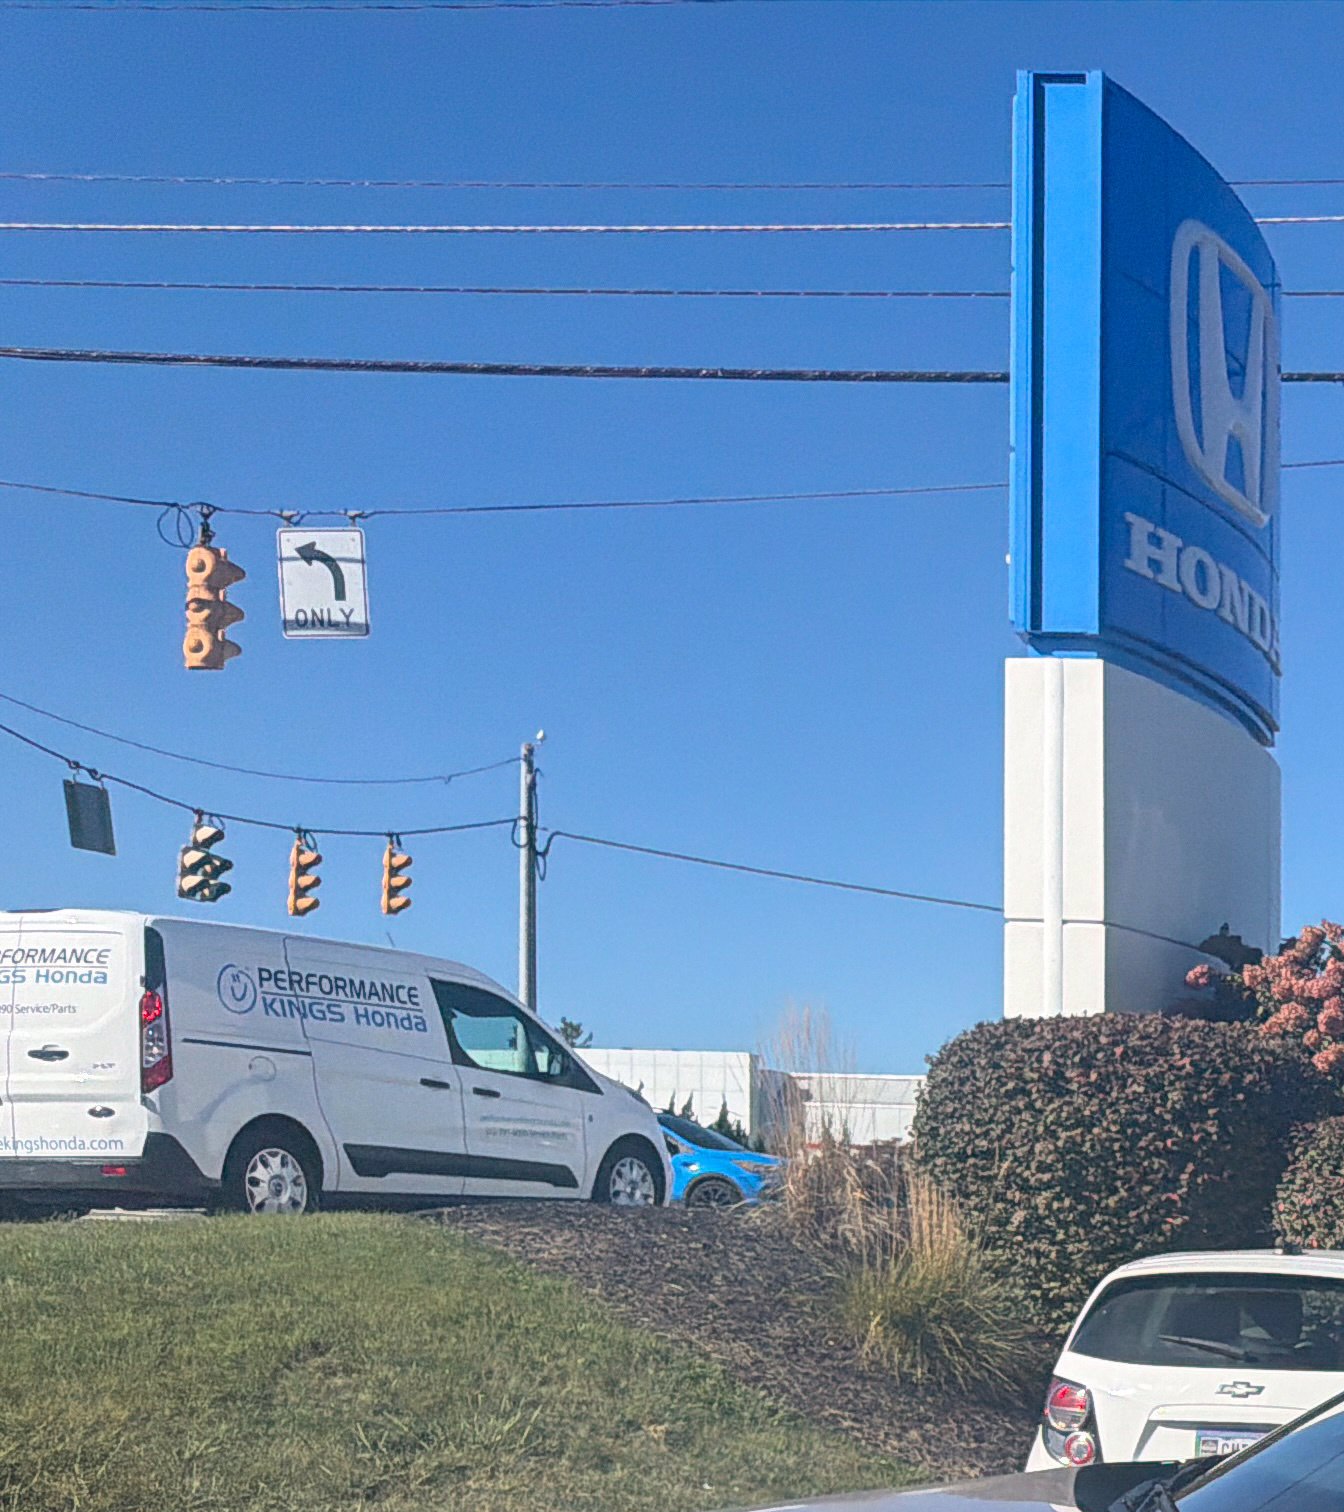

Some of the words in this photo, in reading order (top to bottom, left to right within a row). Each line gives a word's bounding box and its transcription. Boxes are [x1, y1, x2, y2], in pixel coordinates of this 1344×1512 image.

[295, 608, 354, 627] ONLY
[0, 948, 111, 965] FORMANCE
[35, 969, 108, 984] Honda
[258, 967, 420, 1007] PERFORMANCE
[15, 1003, 77, 1014] Service/Parts
[262, 996, 346, 1023] KINGS
[355, 1006, 428, 1033] Honda
